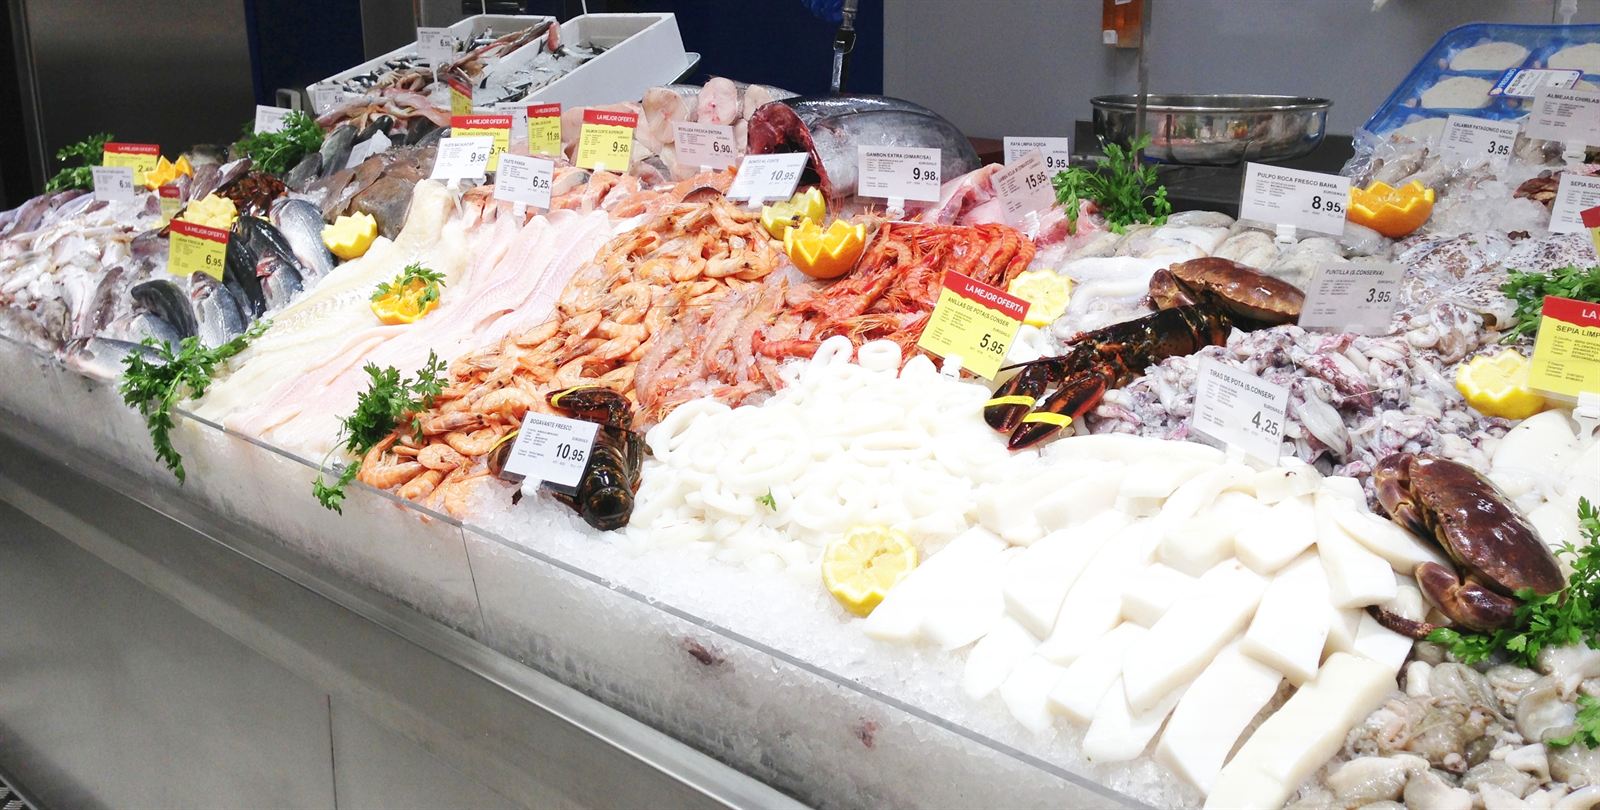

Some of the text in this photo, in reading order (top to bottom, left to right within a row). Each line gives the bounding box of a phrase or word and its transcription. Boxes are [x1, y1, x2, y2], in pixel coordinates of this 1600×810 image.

[1574, 96, 1600, 104] CHIRLAS
[1257, 172, 1276, 180] PULPO
[1294, 178, 1318, 186] FRESCO
[1318, 181, 1338, 189] BAHIA
[192, 227, 207, 235] MEJOR
[207, 230, 226, 238] OFERTA
[948, 296, 967, 309] ANILLAS
[965, 284, 1024, 314] LA MEJOR OFERTA
[1582, 309, 1597, 319] LA
[1556, 324, 1580, 336] SEPIA
[1210, 369, 1224, 380] TIRAS
[1224, 375, 1232, 383] DE
[1231, 378, 1244, 388] POTA
[529, 418, 572, 431] BOGAVANTE FRESCO
